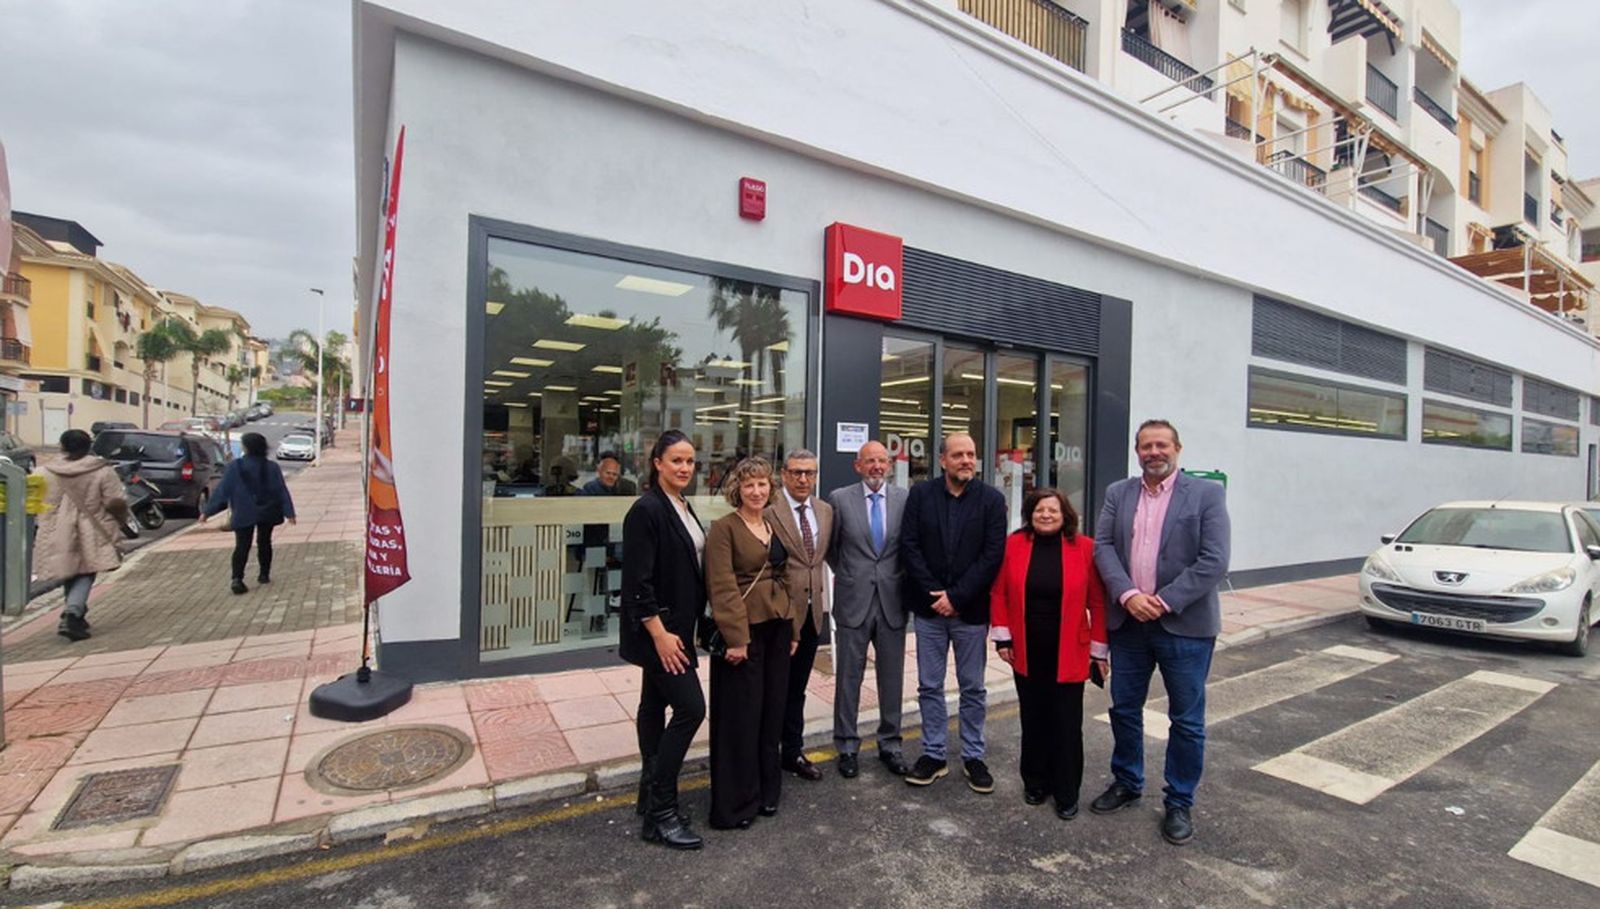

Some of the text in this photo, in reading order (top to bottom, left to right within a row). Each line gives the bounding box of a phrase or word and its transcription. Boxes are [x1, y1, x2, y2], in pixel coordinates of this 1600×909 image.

[843, 252, 895, 291] Dia
[887, 433, 925, 458] Dia
[1055, 441, 1083, 462] Dia
[1421, 614, 1481, 631] 7063 GTR
